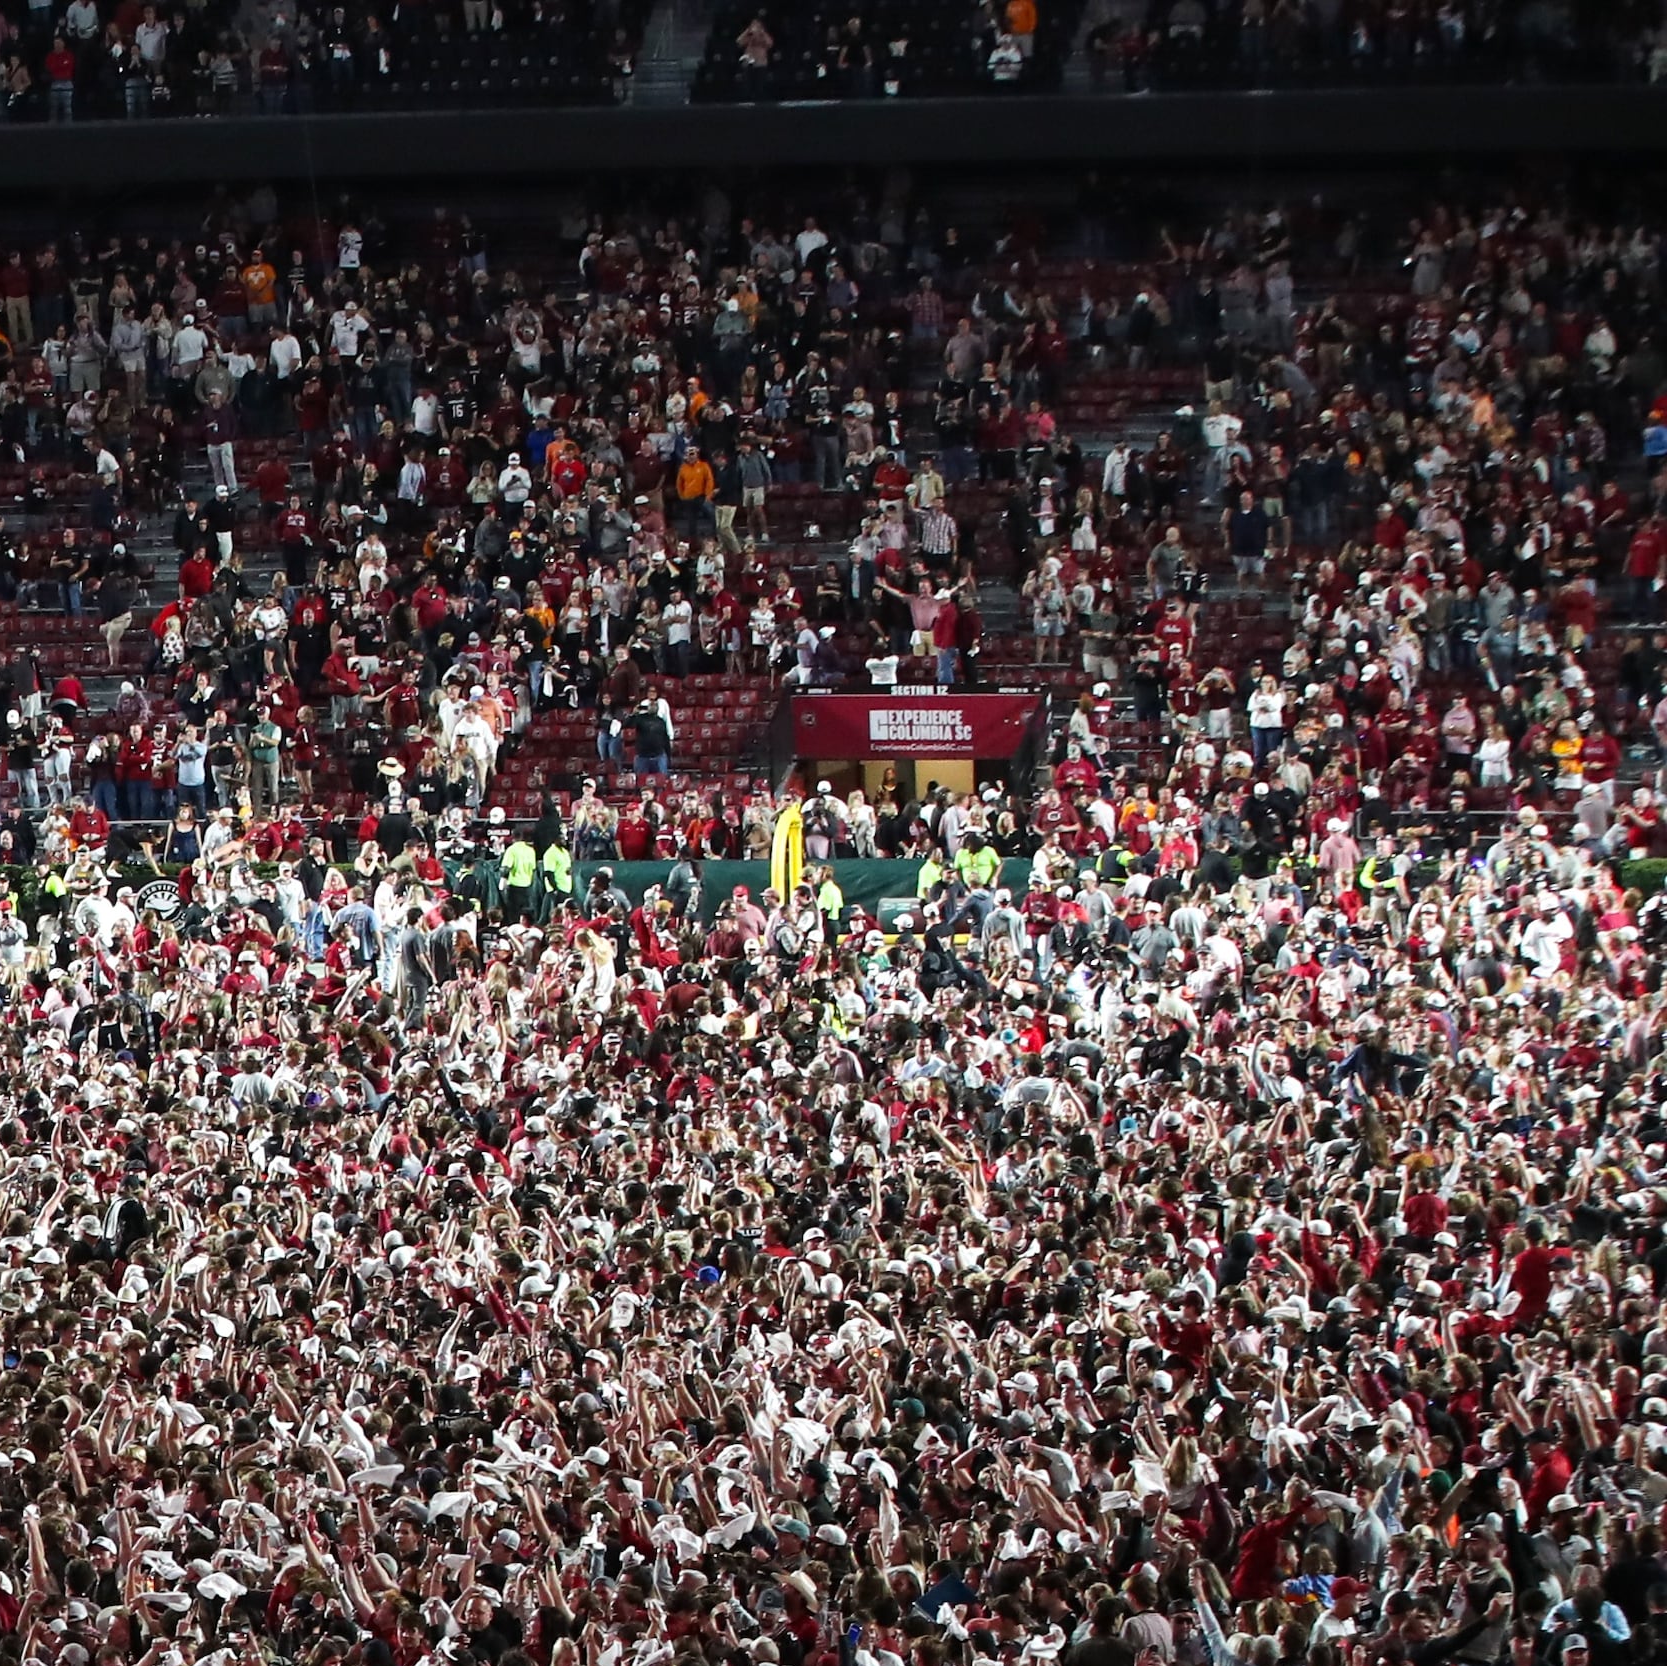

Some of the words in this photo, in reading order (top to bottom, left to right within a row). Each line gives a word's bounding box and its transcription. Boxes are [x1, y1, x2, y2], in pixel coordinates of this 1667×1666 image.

[452, 404, 463, 419] 16
[891, 685, 934, 695] SECTION
[936, 685, 949, 695] 12
[1184, 692, 1190, 707] 1
[889, 710, 963, 725] EXPERIENCE
[889, 725, 953, 741] COLUMBIA
[955, 725, 972, 741] SC
